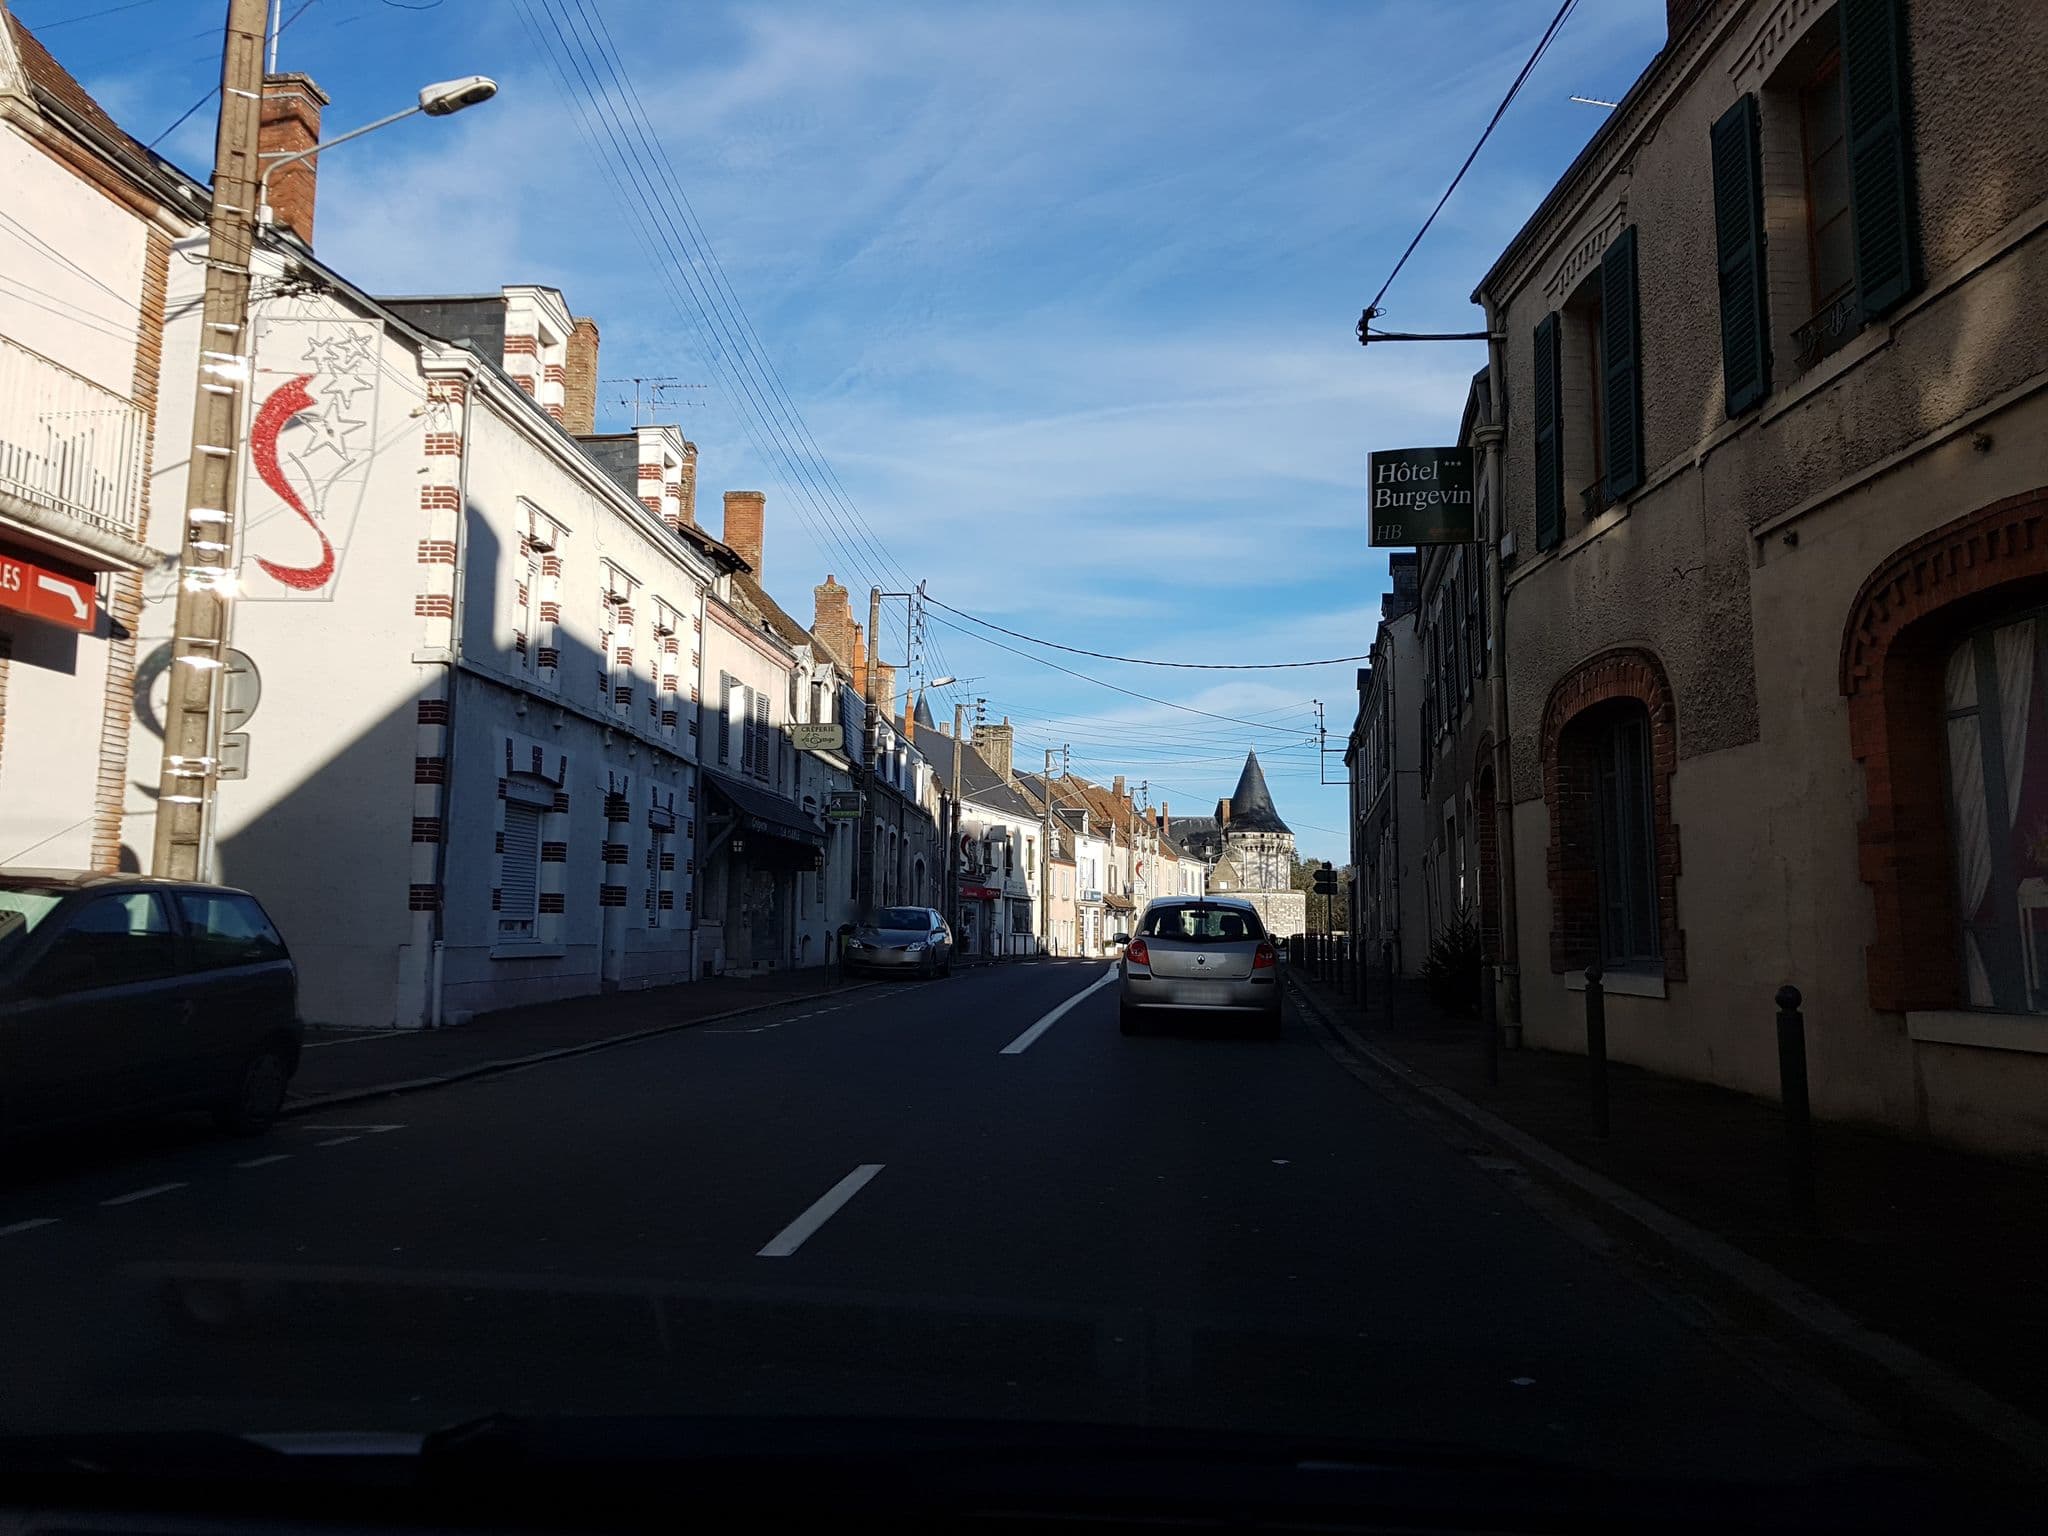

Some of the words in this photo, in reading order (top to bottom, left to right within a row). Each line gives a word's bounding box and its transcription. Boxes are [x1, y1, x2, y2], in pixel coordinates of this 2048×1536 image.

[1375, 460, 1439, 485] Hôtel
[1375, 483, 1472, 511] Burgevin
[1376, 523, 1402, 541] HB
